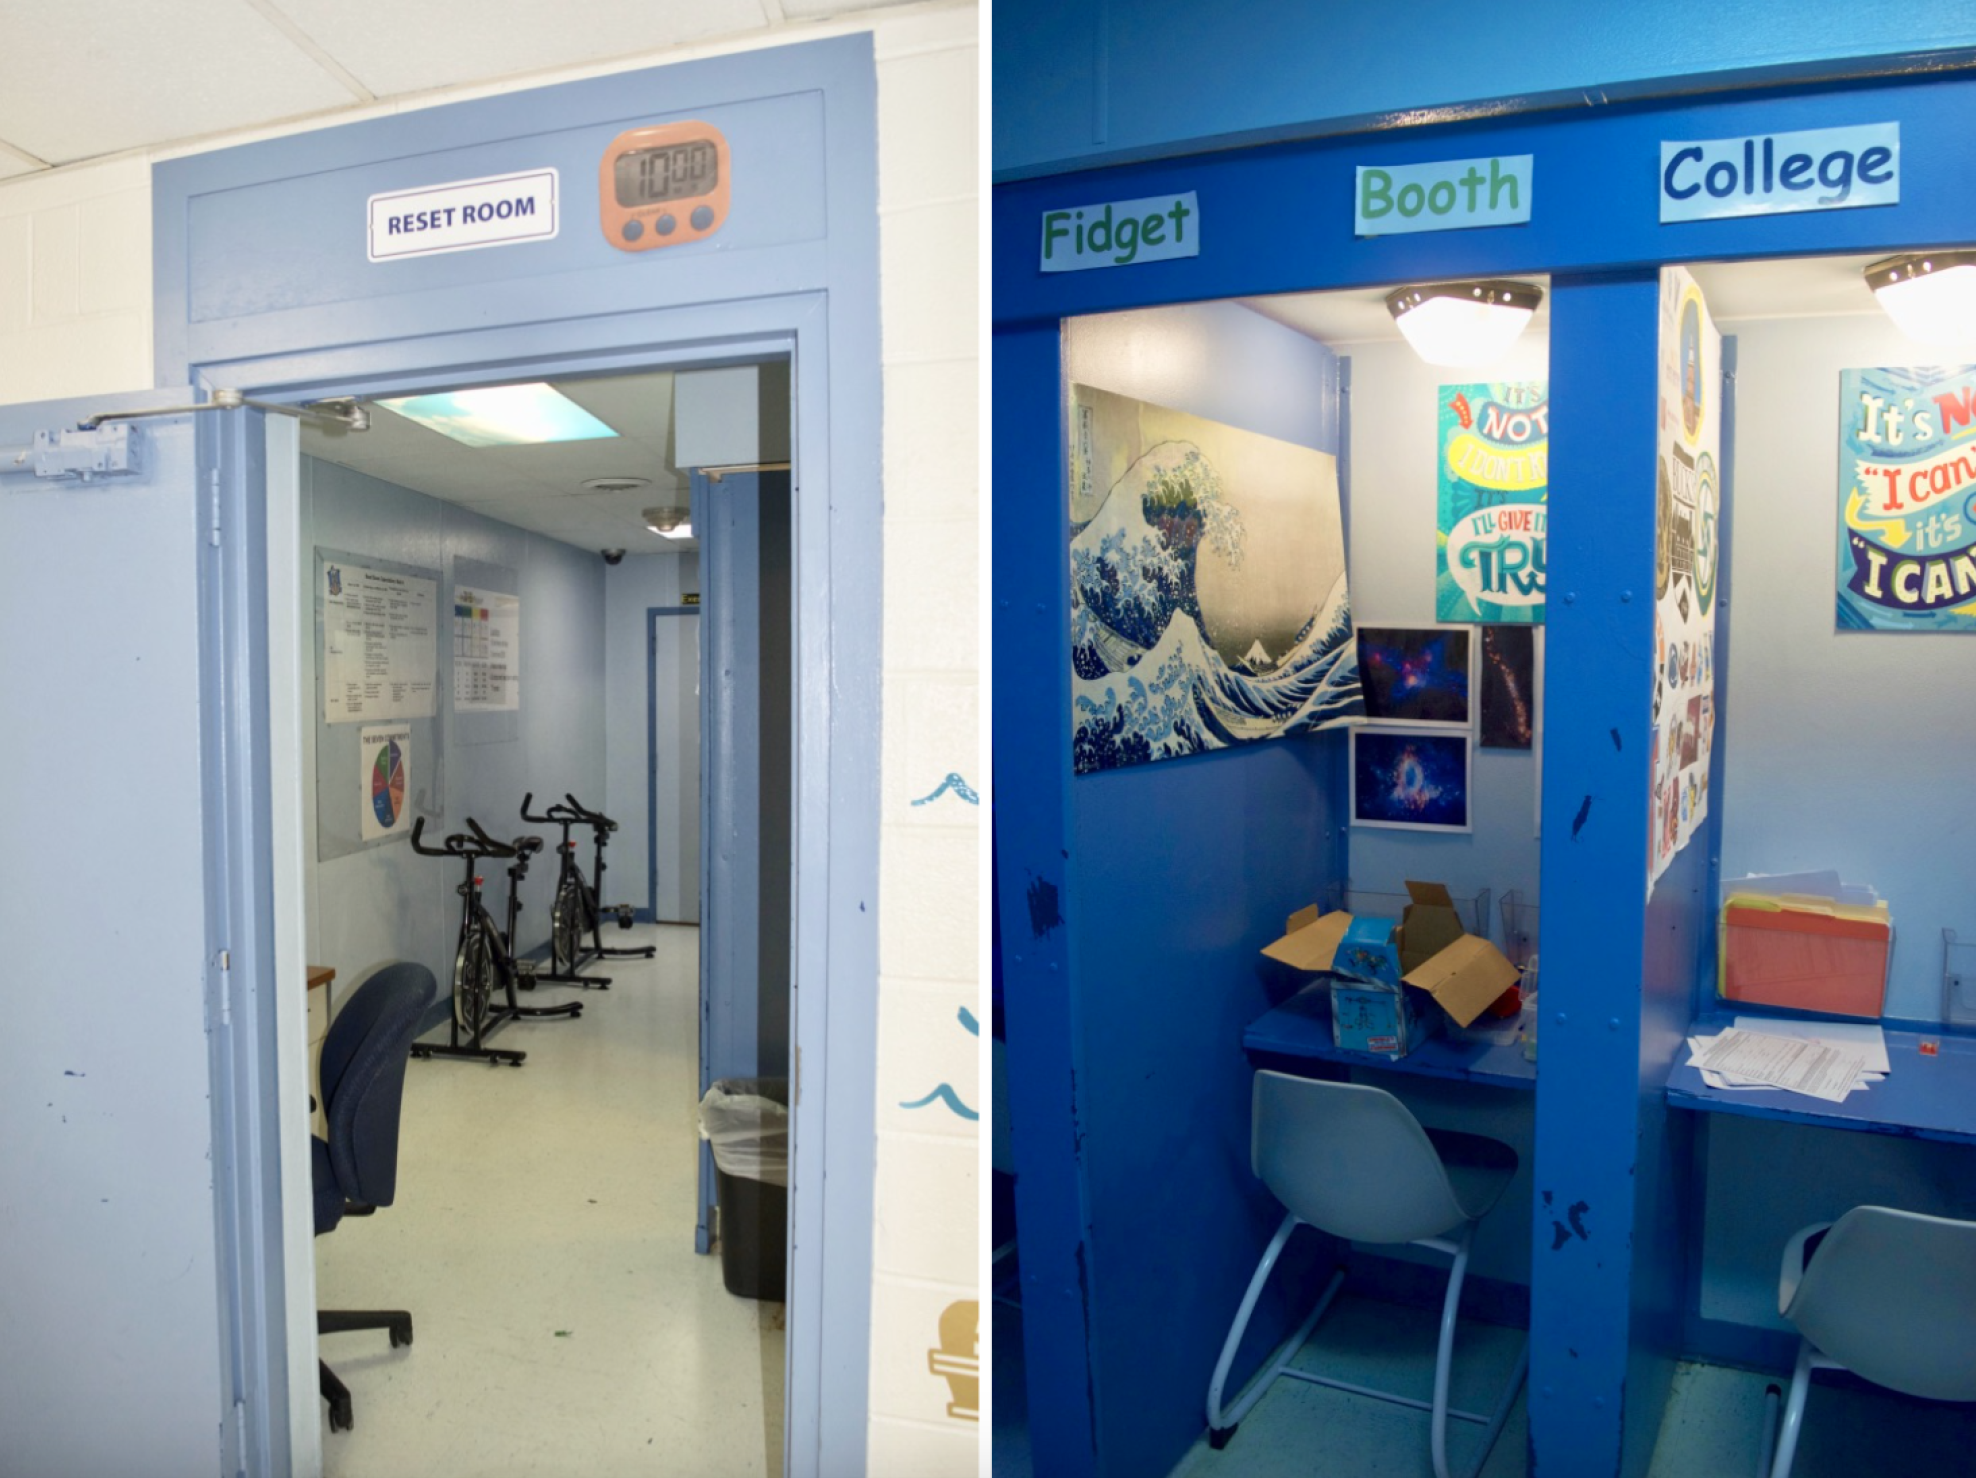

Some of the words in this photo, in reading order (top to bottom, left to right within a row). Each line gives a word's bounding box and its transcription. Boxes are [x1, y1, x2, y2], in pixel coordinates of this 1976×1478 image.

[1361, 158, 1519, 220] Booth
[1664, 137, 1894, 205] College
[388, 208, 456, 236] RESET
[462, 196, 536, 225] ROOM
[1044, 200, 1190, 264] Fidget
[1504, 386, 1541, 404] IT'S
[1483, 405, 1548, 442] NOT
[1856, 390, 1934, 446] It's
[1931, 386, 1976, 435] N
[1458, 444, 1475, 468] I
[1498, 510, 1533, 532] GIVE
[1915, 513, 1963, 552] it's
